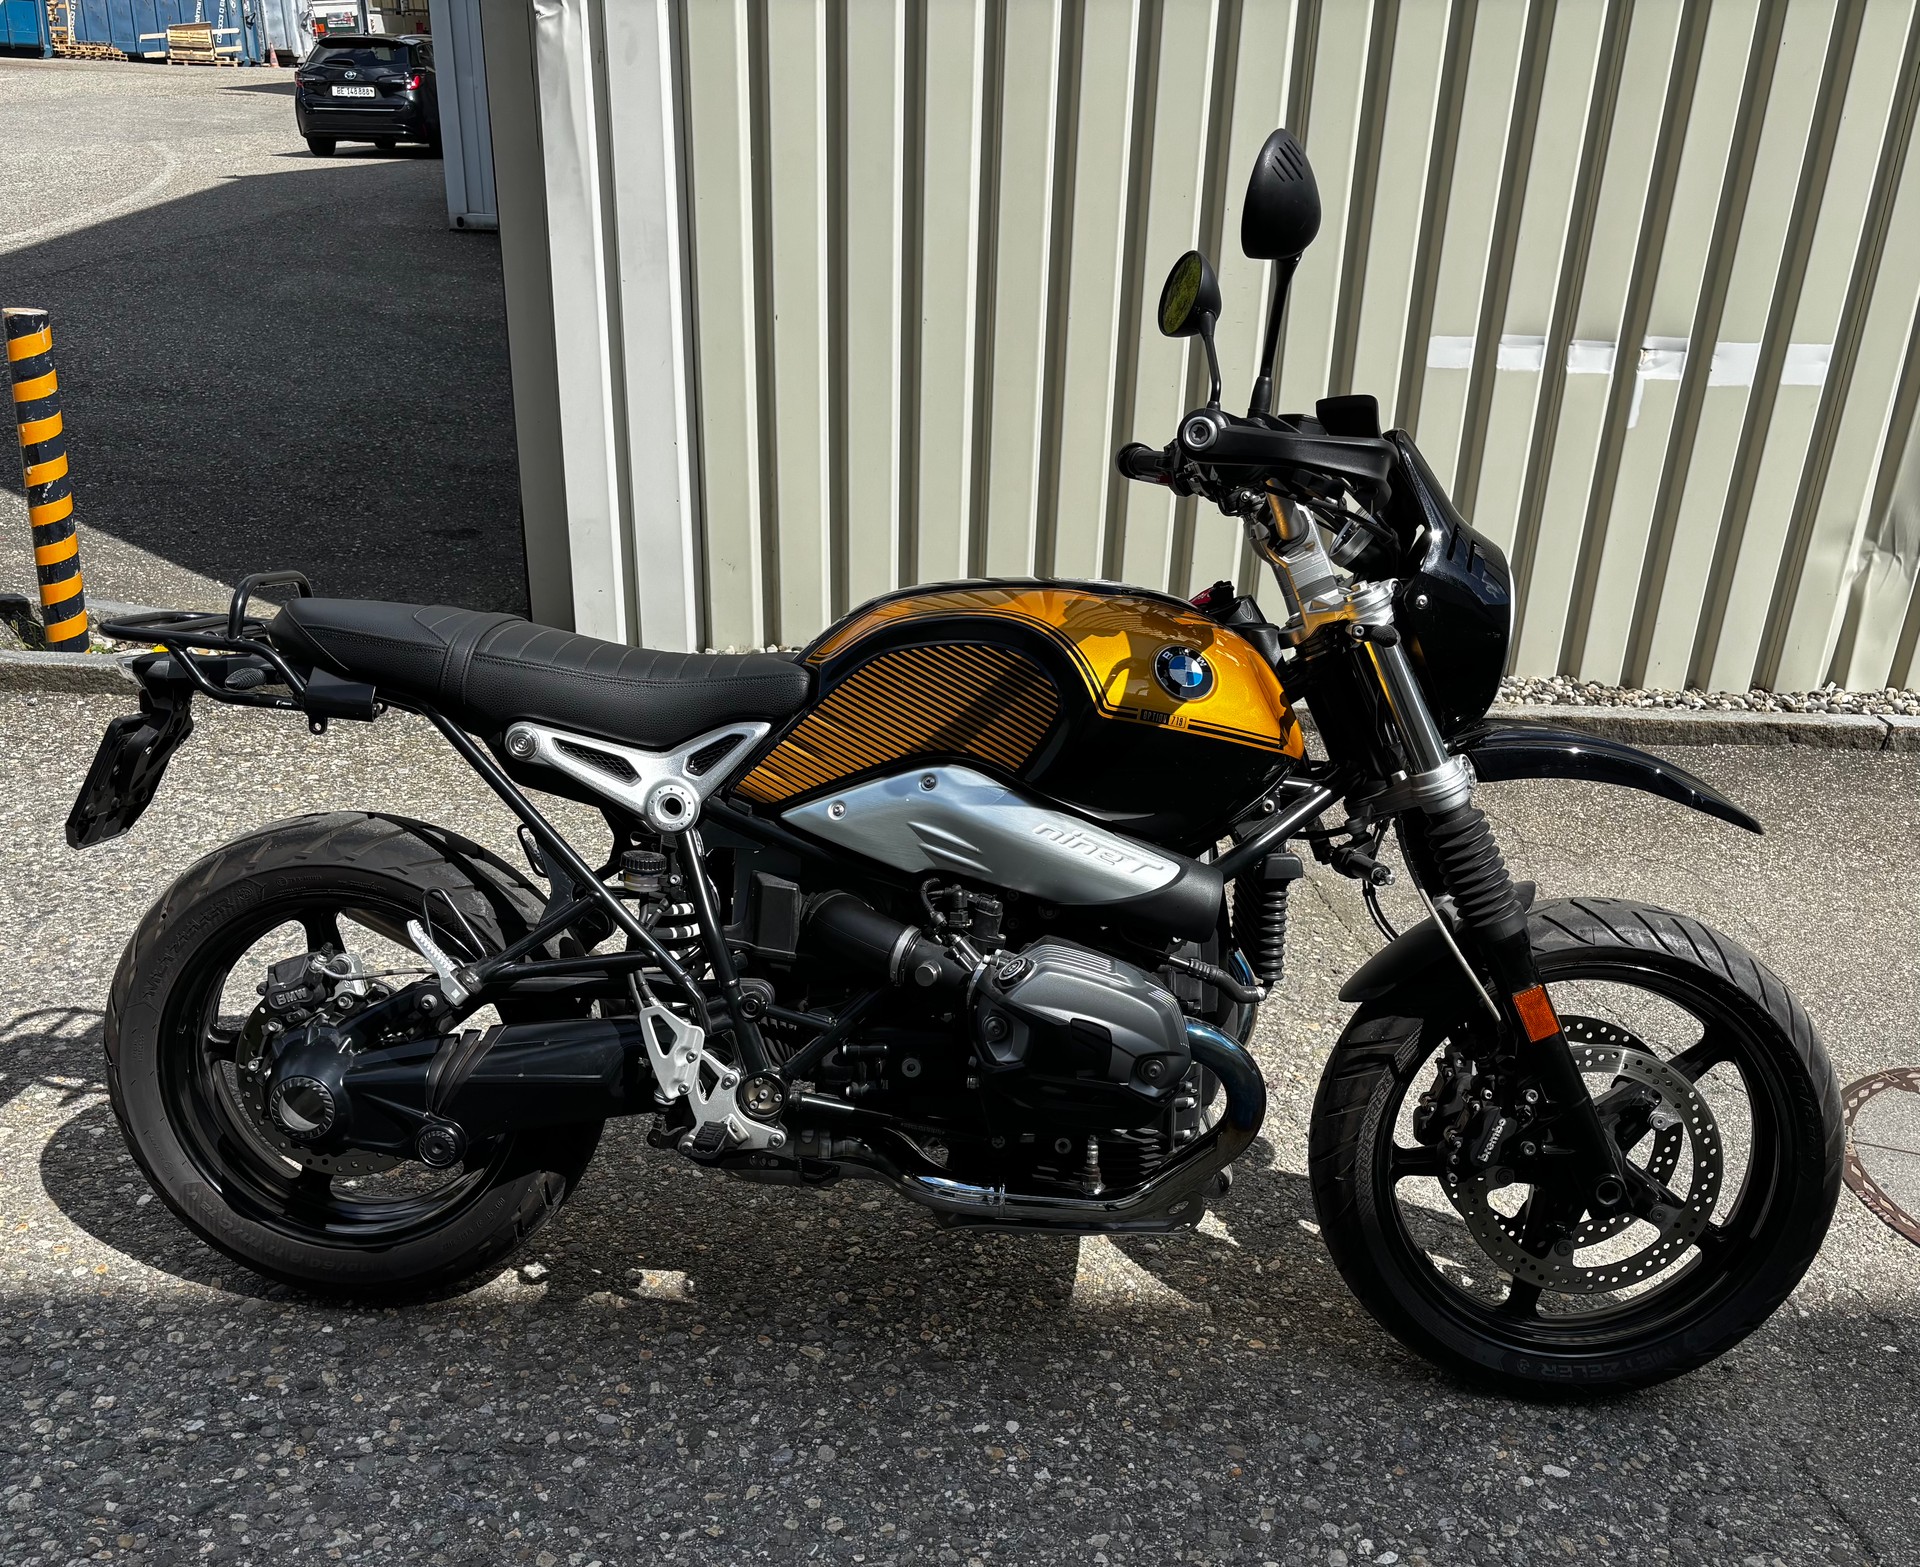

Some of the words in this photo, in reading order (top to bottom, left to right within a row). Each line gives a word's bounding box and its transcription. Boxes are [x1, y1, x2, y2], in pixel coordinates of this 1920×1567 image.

[1142, 710, 1168, 724] OPTION
[1171, 716, 1184, 727] 719
[275, 987, 307, 1005] BMW
[1477, 1118, 1507, 1162] brembo
